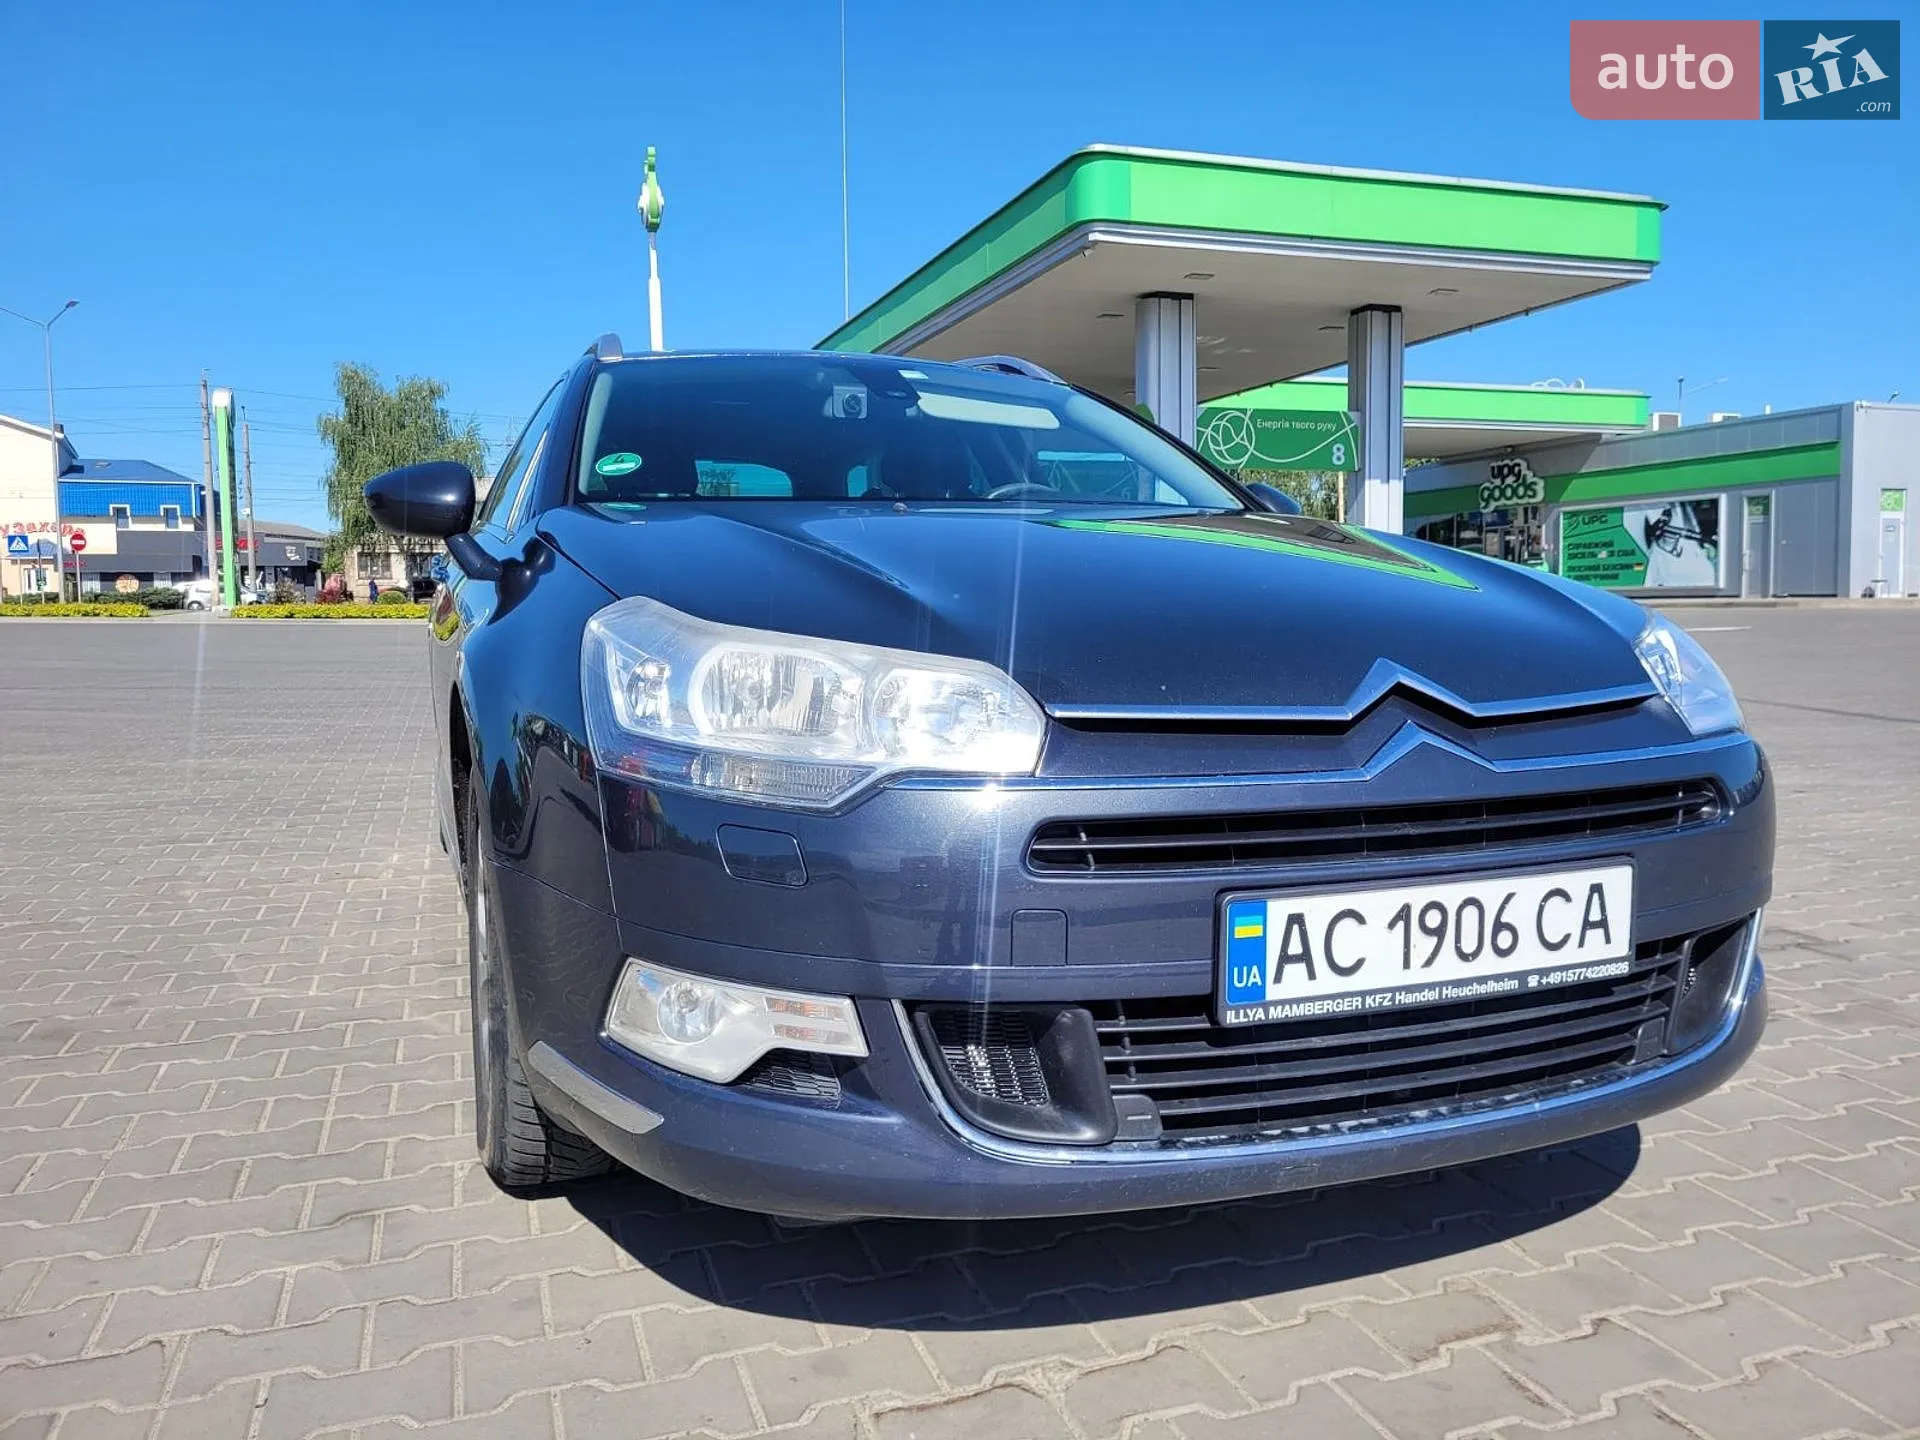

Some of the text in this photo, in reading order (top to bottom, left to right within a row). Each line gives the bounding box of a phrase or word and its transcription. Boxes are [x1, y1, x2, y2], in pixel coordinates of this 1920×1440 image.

[1256, 418, 1337, 432] Енергія твого руку
[1332, 443, 1345, 466] 8
[1490, 462, 1522, 485] upg
[1480, 474, 1538, 509] goods
[1272, 882, 1613, 986] AC 1906 CA
[1233, 964, 1263, 989] UA
[1226, 1009, 1265, 1024] ILLYA
[1268, 997, 1362, 1020] MAMBERGER
[1365, 993, 1392, 1009] KFZ
[1395, 987, 1439, 1005] Handel
[1441, 977, 1519, 1000] Heuchelheim
